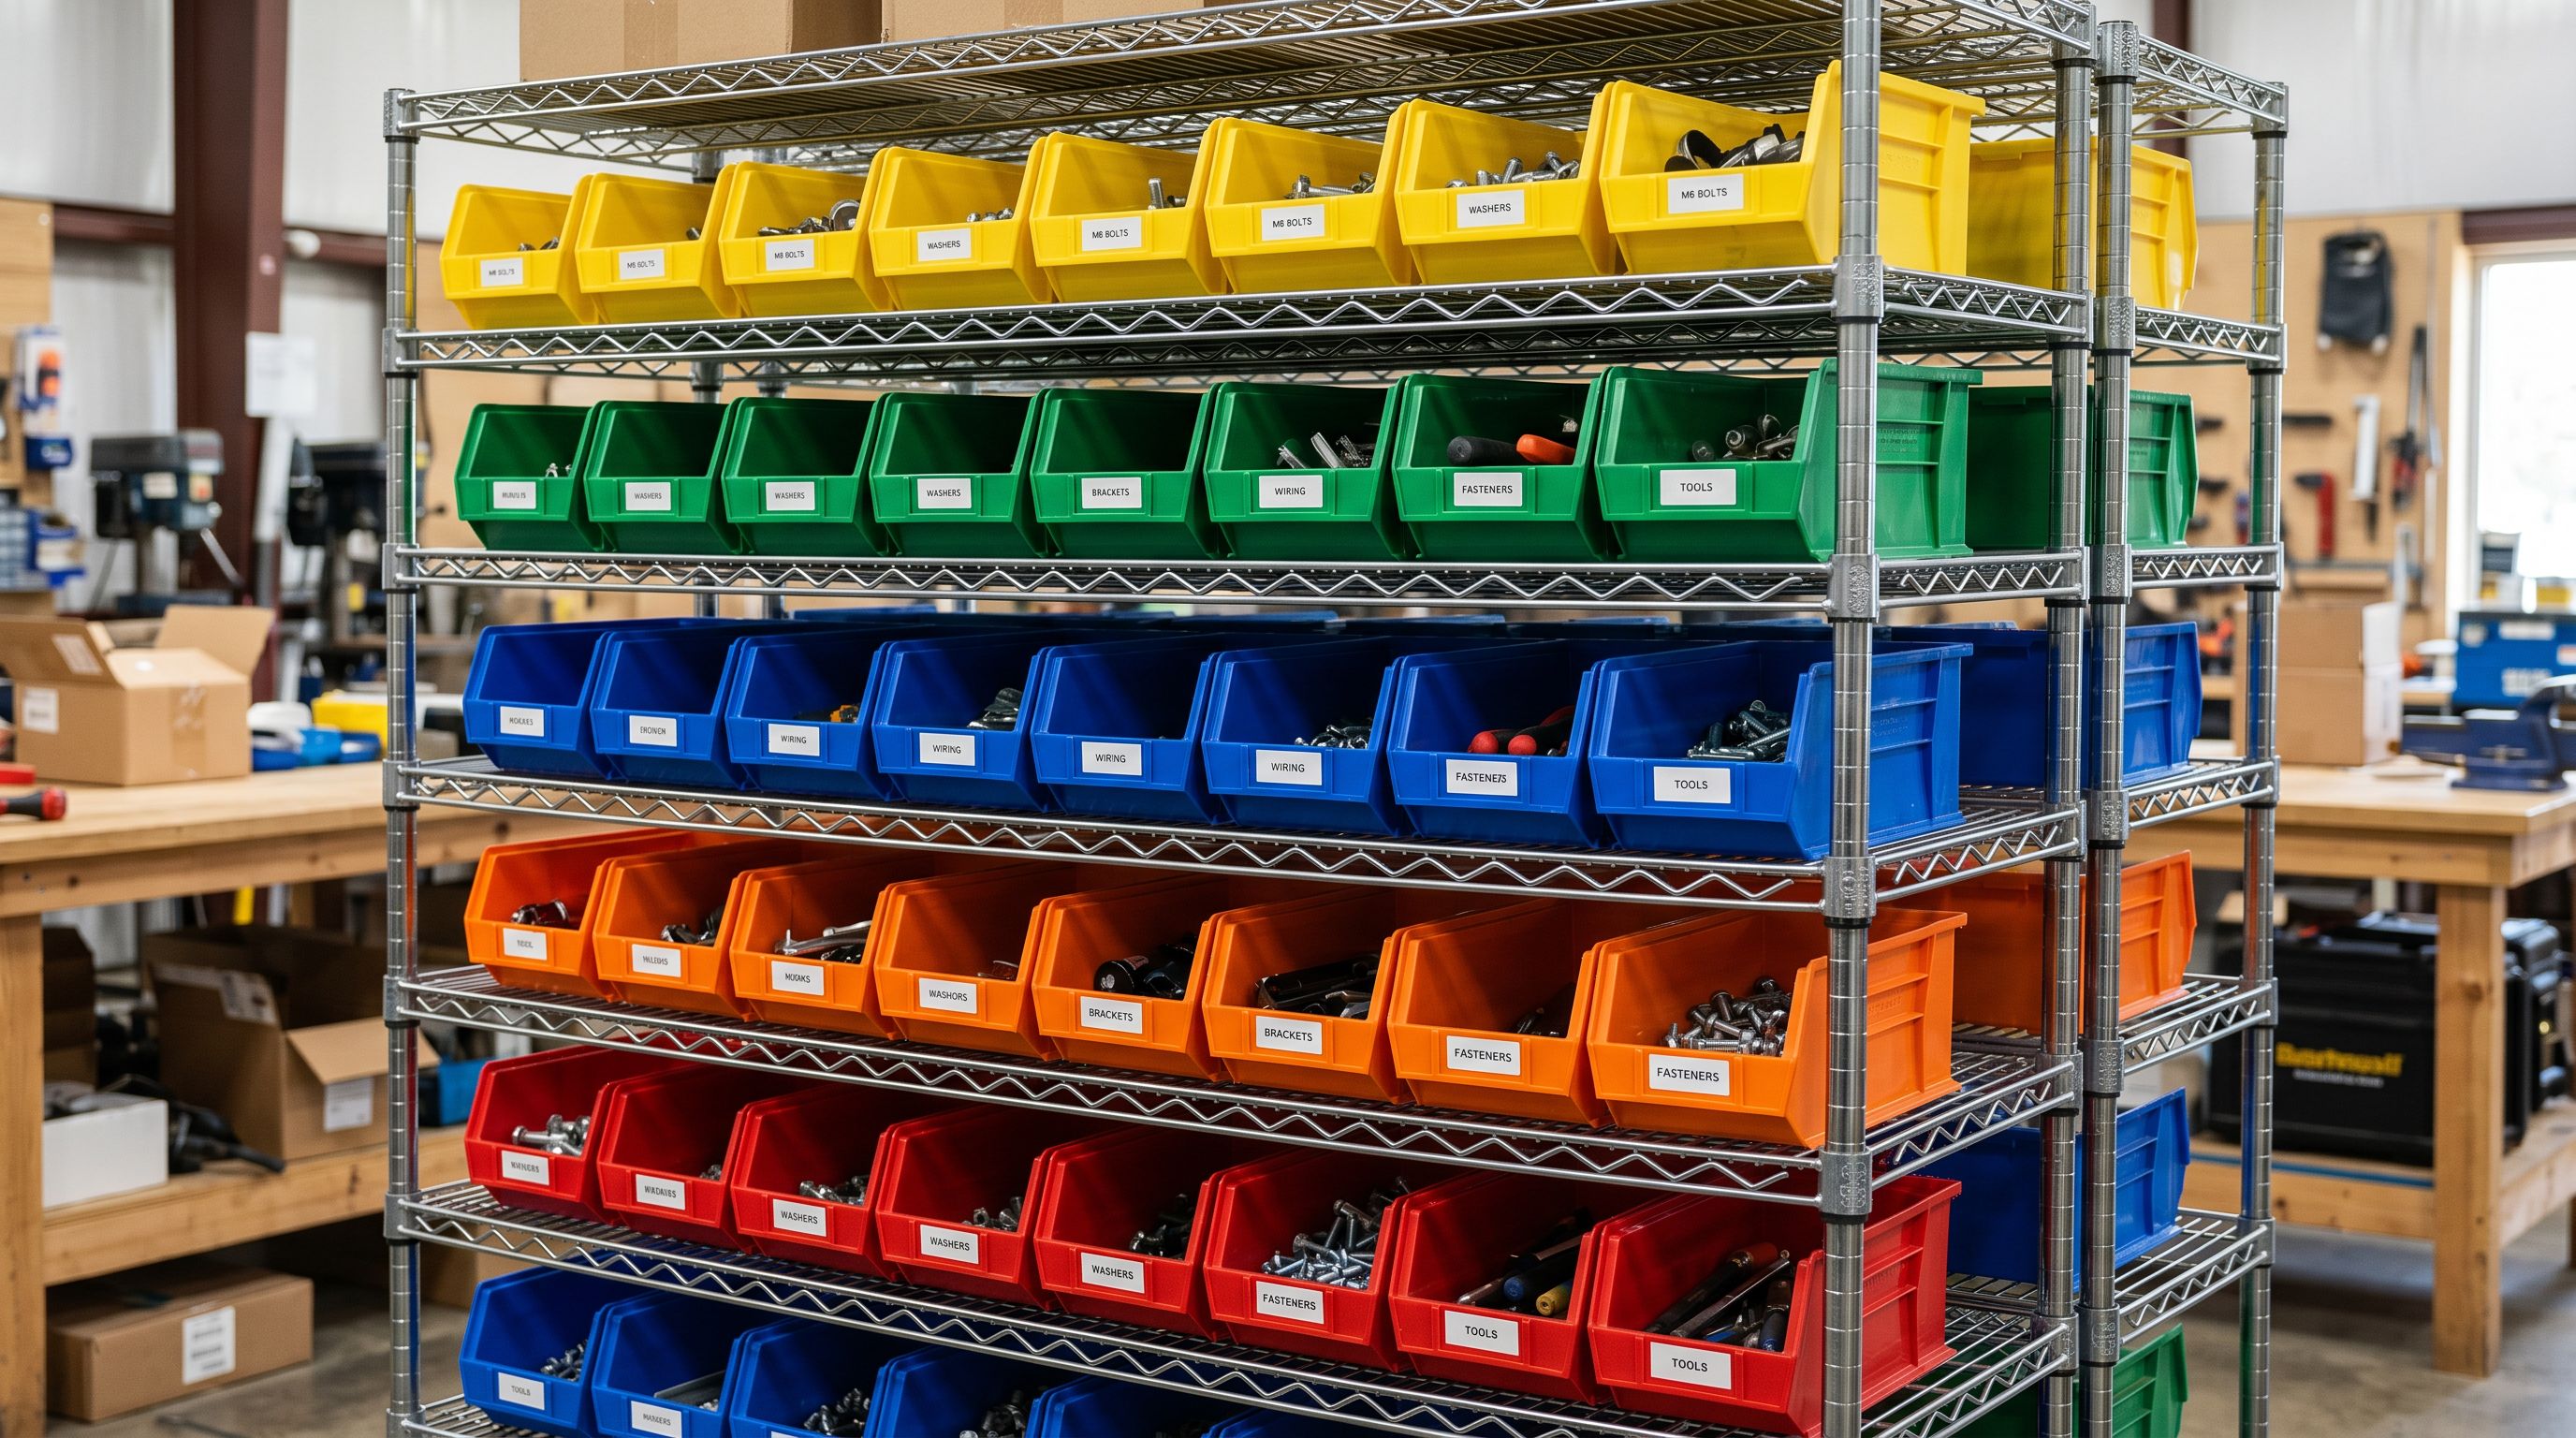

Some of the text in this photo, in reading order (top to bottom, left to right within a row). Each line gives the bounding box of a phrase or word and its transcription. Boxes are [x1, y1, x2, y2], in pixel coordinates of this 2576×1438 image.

[1681, 187, 1728, 199] M6 BOLTS
[1469, 203, 1512, 214] WASHERS
[1272, 219, 1285, 228] M6
[1092, 228, 1129, 240] M6 BOLTS
[928, 240, 961, 249] WASHERS
[927, 488, 961, 496] WASHERS
[1092, 488, 1129, 496] BRACKETS
[1275, 486, 1307, 495] WIRING
[1462, 484, 1513, 493] FASTENERS
[1680, 482, 1713, 492] TOOLS
[781, 735, 807, 744] WIRING
[932, 742, 962, 755] WIRING
[1094, 753, 1127, 764] WIRING
[1271, 762, 1306, 772] WIRING
[1674, 779, 1708, 789] TOOLS
[1090, 1008, 1134, 1022] BRACKETS
[1264, 1027, 1313, 1042] BRACKETS
[1454, 1048, 1513, 1063] FASTENERS
[1657, 1066, 1720, 1082] FASTENERS
[781, 1211, 818, 1225] WASHERS
[929, 1236, 971, 1252] WASHERS
[1090, 1264, 1134, 1280] WASHERS
[1263, 1293, 1317, 1310] FASTENERS
[1465, 1325, 1500, 1340] TOOLS
[1671, 1357, 1708, 1372] TOOLS
